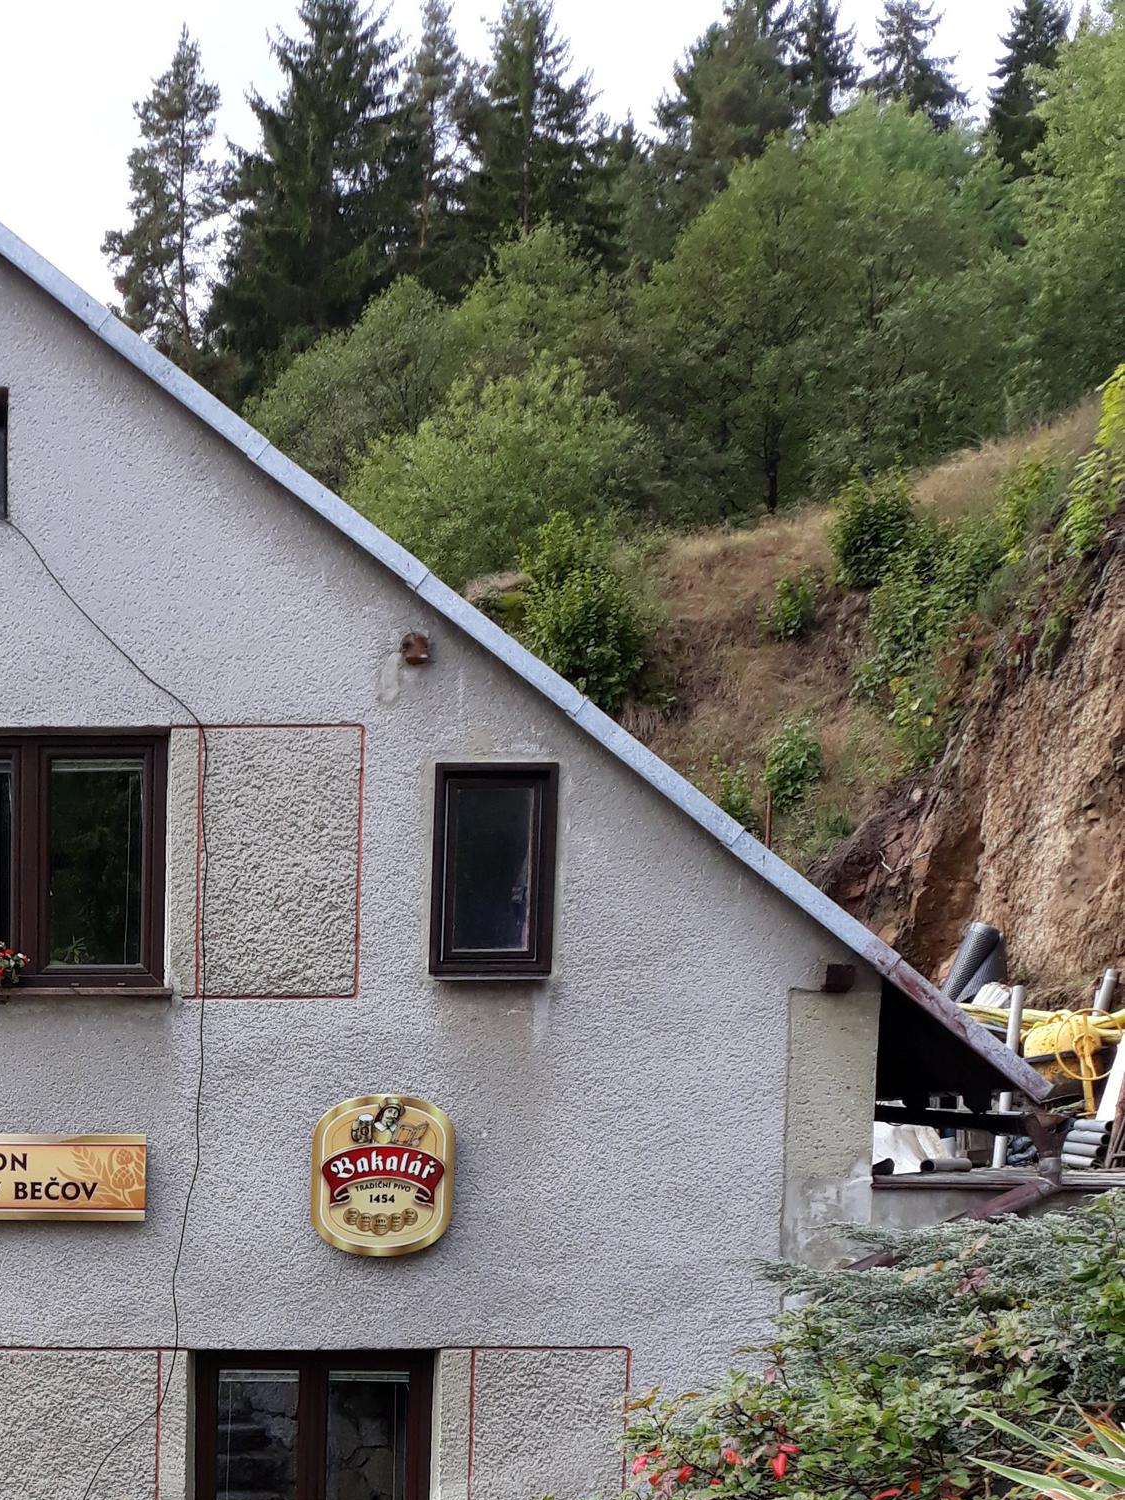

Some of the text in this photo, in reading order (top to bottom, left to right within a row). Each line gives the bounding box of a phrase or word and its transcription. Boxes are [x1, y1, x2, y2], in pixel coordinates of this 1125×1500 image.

[330, 1150, 437, 1180] Bakalář
[13, 1176, 98, 1202] BEČOV
[355, 1180, 411, 1193] TRADIČNÍ PIVO
[369, 1194, 396, 1204] 1454
